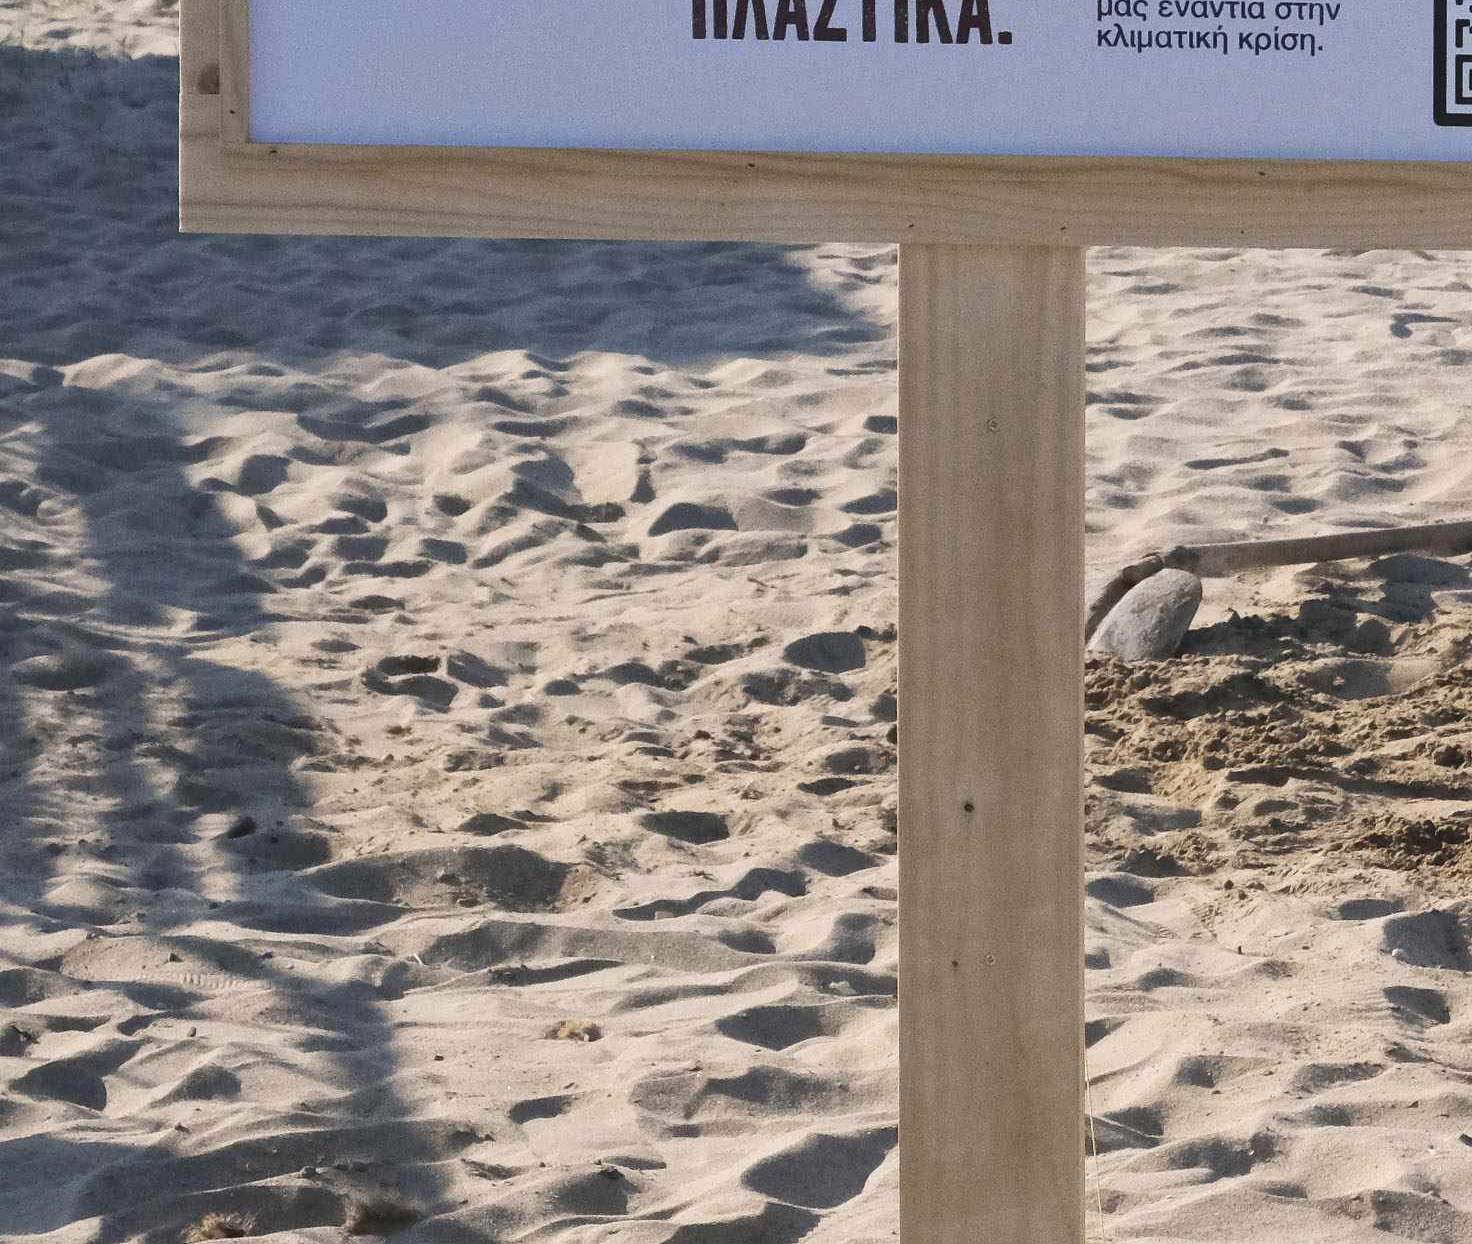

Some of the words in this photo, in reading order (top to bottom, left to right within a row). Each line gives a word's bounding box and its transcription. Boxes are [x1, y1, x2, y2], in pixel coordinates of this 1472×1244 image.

[1098, 0, 1148, 21] μας
[1275, 2, 1340, 25] στην
[1098, 23, 1227, 54] κλιματική
[1239, 26, 1322, 56] κρίση.
